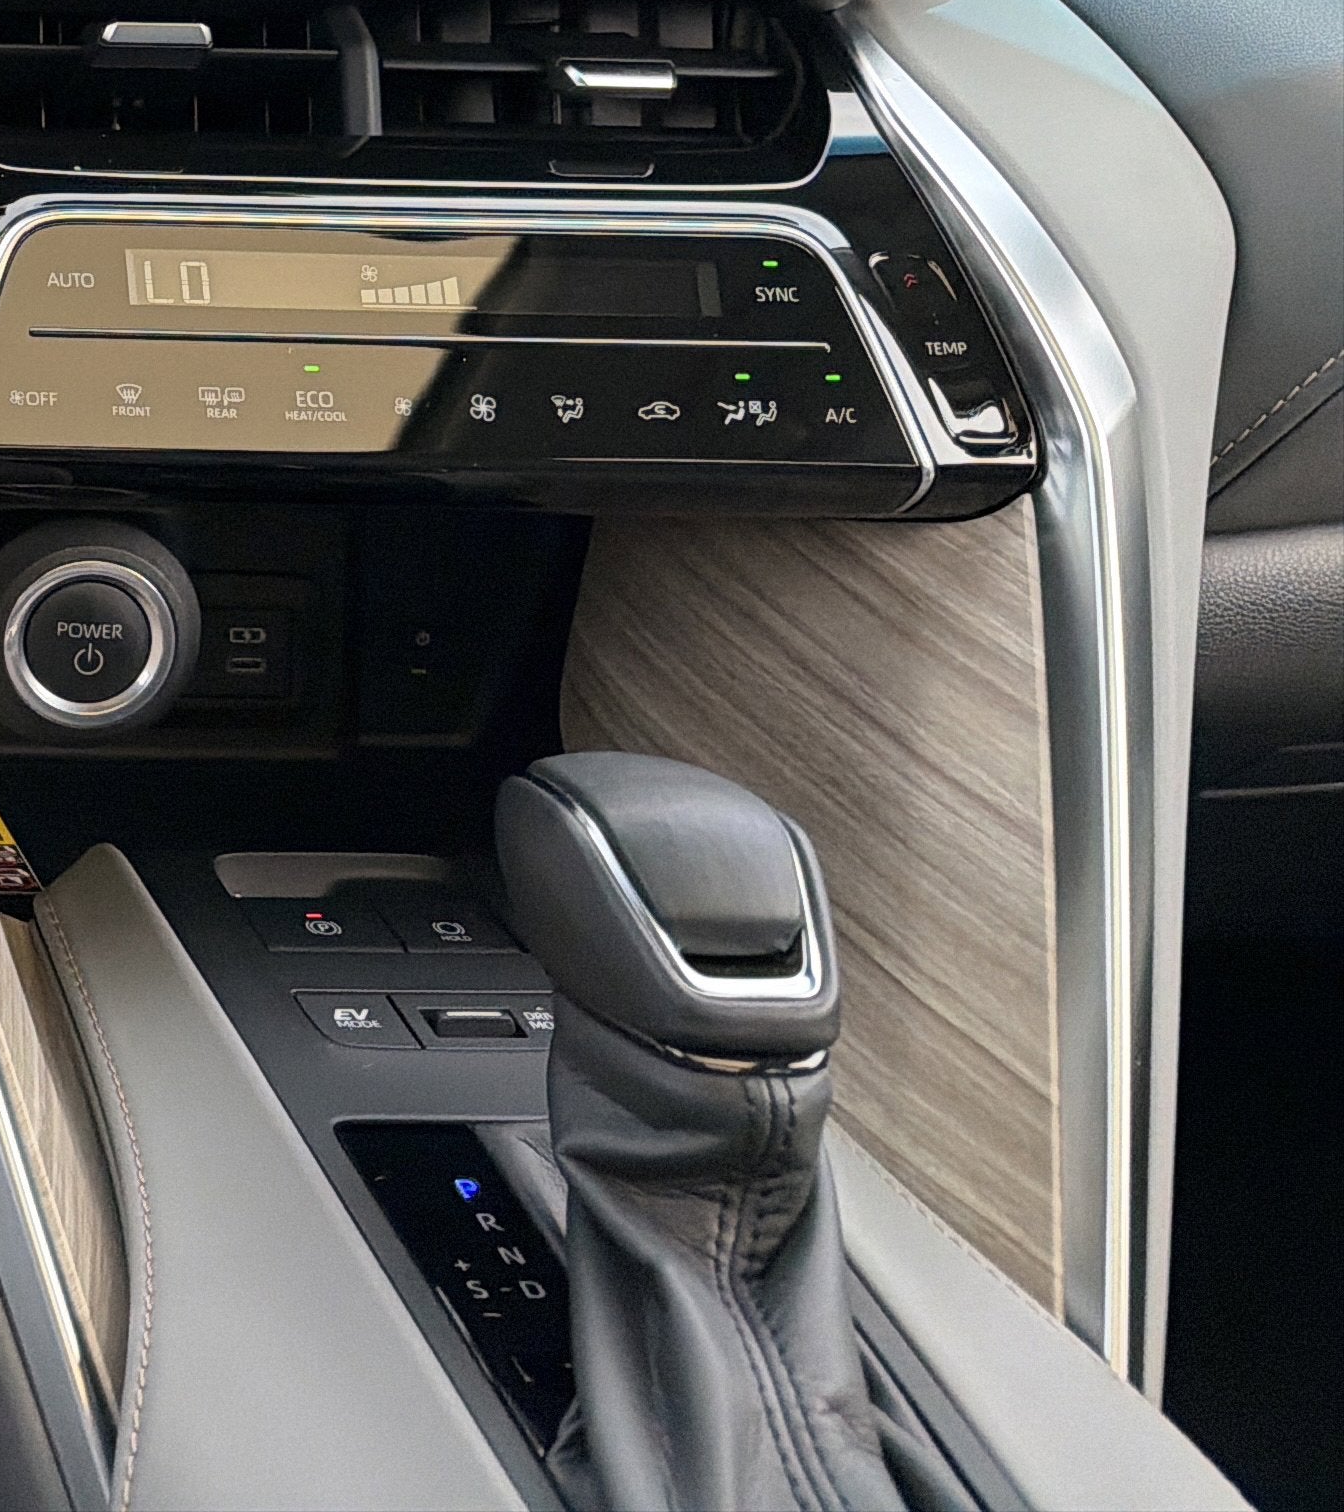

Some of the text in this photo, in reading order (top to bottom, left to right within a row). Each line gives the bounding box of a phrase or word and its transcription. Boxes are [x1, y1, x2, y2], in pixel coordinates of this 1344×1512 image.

[47, 272, 95, 289] AUTO
[755, 286, 800, 303] SYNC
[924, 341, 967, 356] TEMP
[25, 391, 59, 407] OFF
[295, 390, 334, 408] ECO
[112, 405, 150, 417] FRONT
[206, 407, 238, 419] REAR
[285, 411, 348, 422] HEAT/COOL
[825, 406, 858, 424] A/C
[56, 621, 124, 640] POWER
[334, 1008, 369, 1020] EV
[335, 1019, 382, 1029] MODE
[528, 1020, 554, 1030] MO
[454, 1177, 481, 1202] P
[475, 1212, 505, 1231] R
[497, 1246, 526, 1265] N
[465, 1280, 547, 1299] S D
